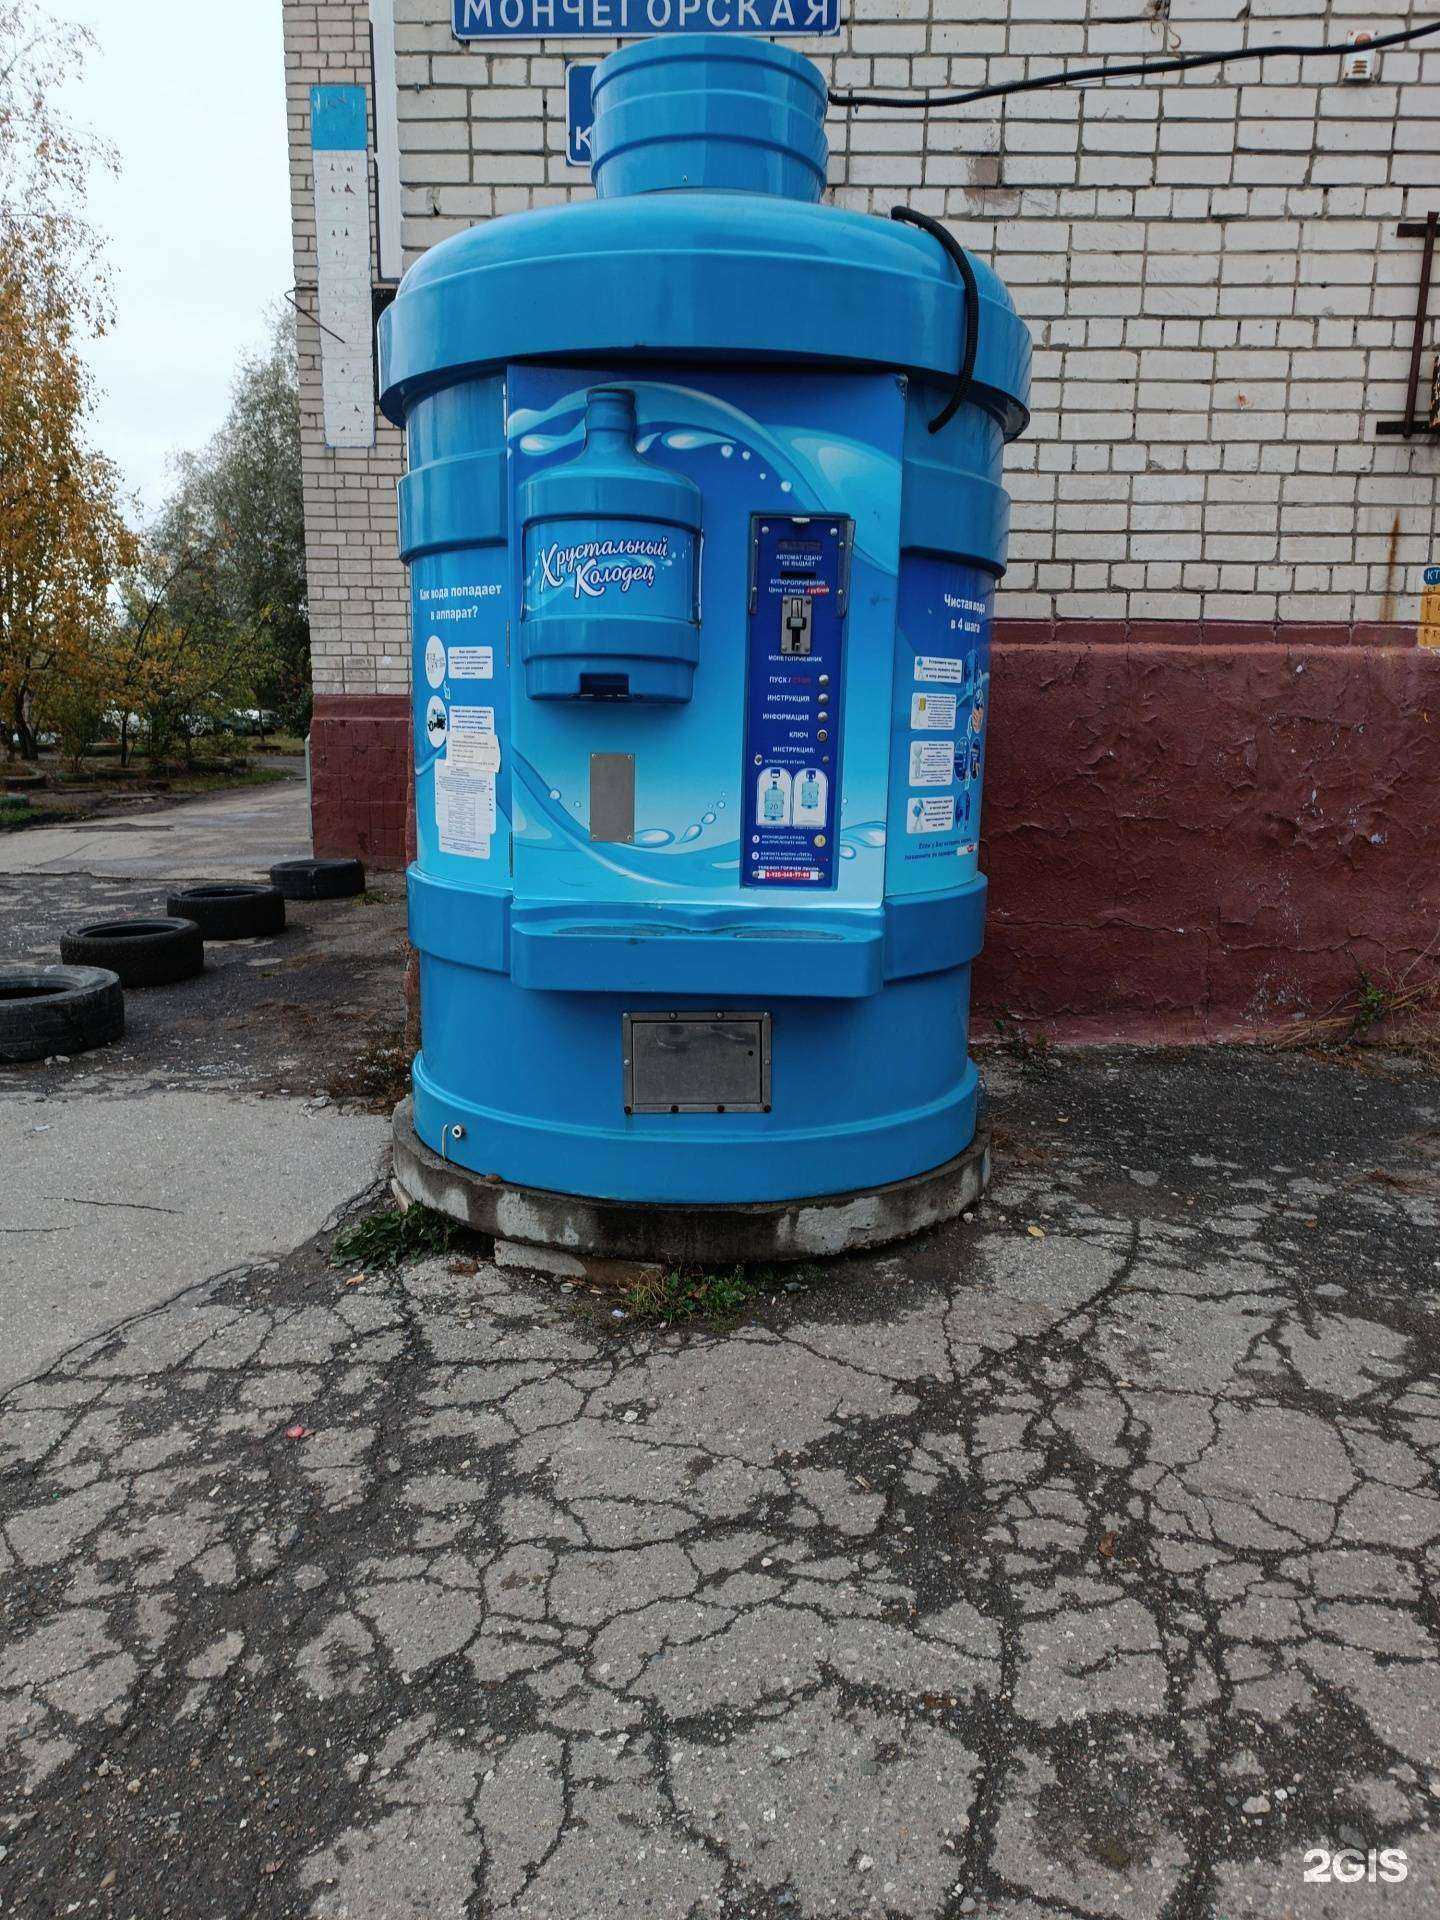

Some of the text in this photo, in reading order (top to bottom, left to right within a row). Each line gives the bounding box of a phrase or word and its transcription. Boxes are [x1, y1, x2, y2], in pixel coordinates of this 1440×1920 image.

[463, 0, 829, 28] МОНЧЕГОРСКАЯ
[540, 535, 670, 593] Хрустальный
[574, 557, 656, 600] Колодец
[419, 584, 502, 600] Как вода попадает
[436, 605, 479, 622] аппарат?
[943, 593, 986, 617] Чистая вода
[957, 617, 963, 631] 4
[964, 622, 981, 634] шага
[769, 676, 787, 684] ПУСК
[767, 694, 810, 702] ИНСТРУКЦИЯ
[762, 713, 810, 721] ИНФОРМАЦИЯ
[789, 731, 809, 739] КЛЮЧ
